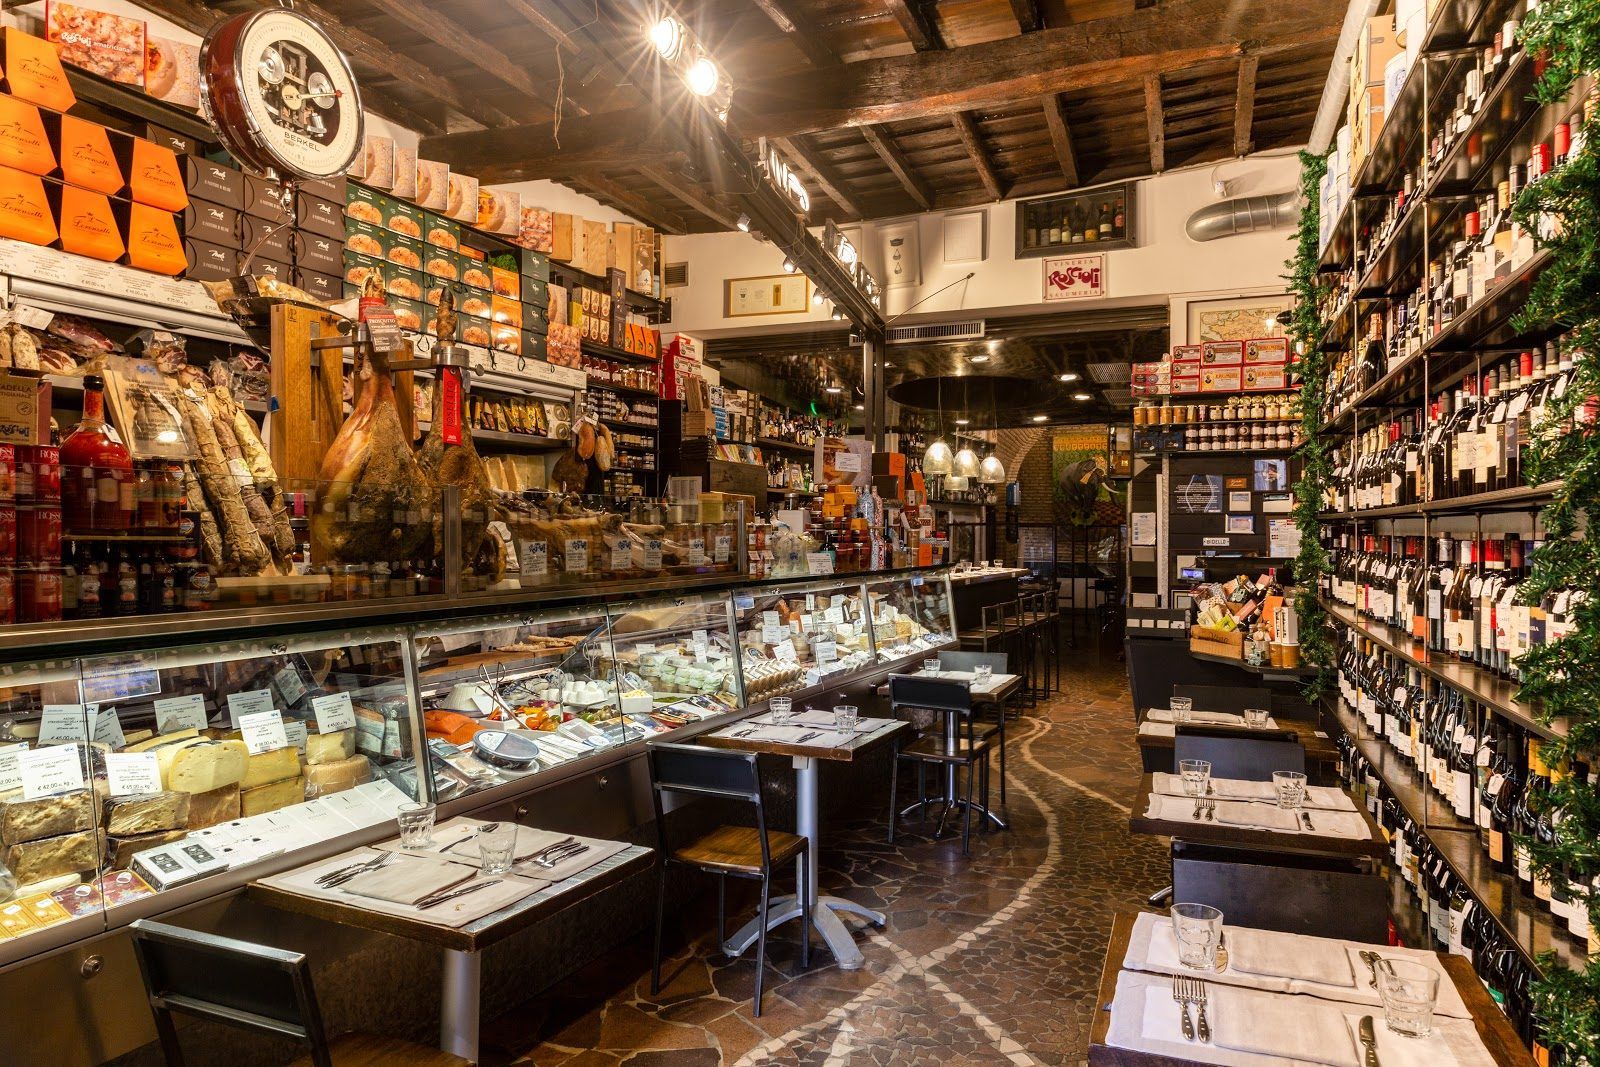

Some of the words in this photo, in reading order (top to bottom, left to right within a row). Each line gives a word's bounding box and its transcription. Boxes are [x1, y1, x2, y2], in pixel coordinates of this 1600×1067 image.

[285, 132, 320, 152] BERKEL
[1053, 259, 1094, 267] VINERIA
[0, 383, 32, 393] ADELLA
